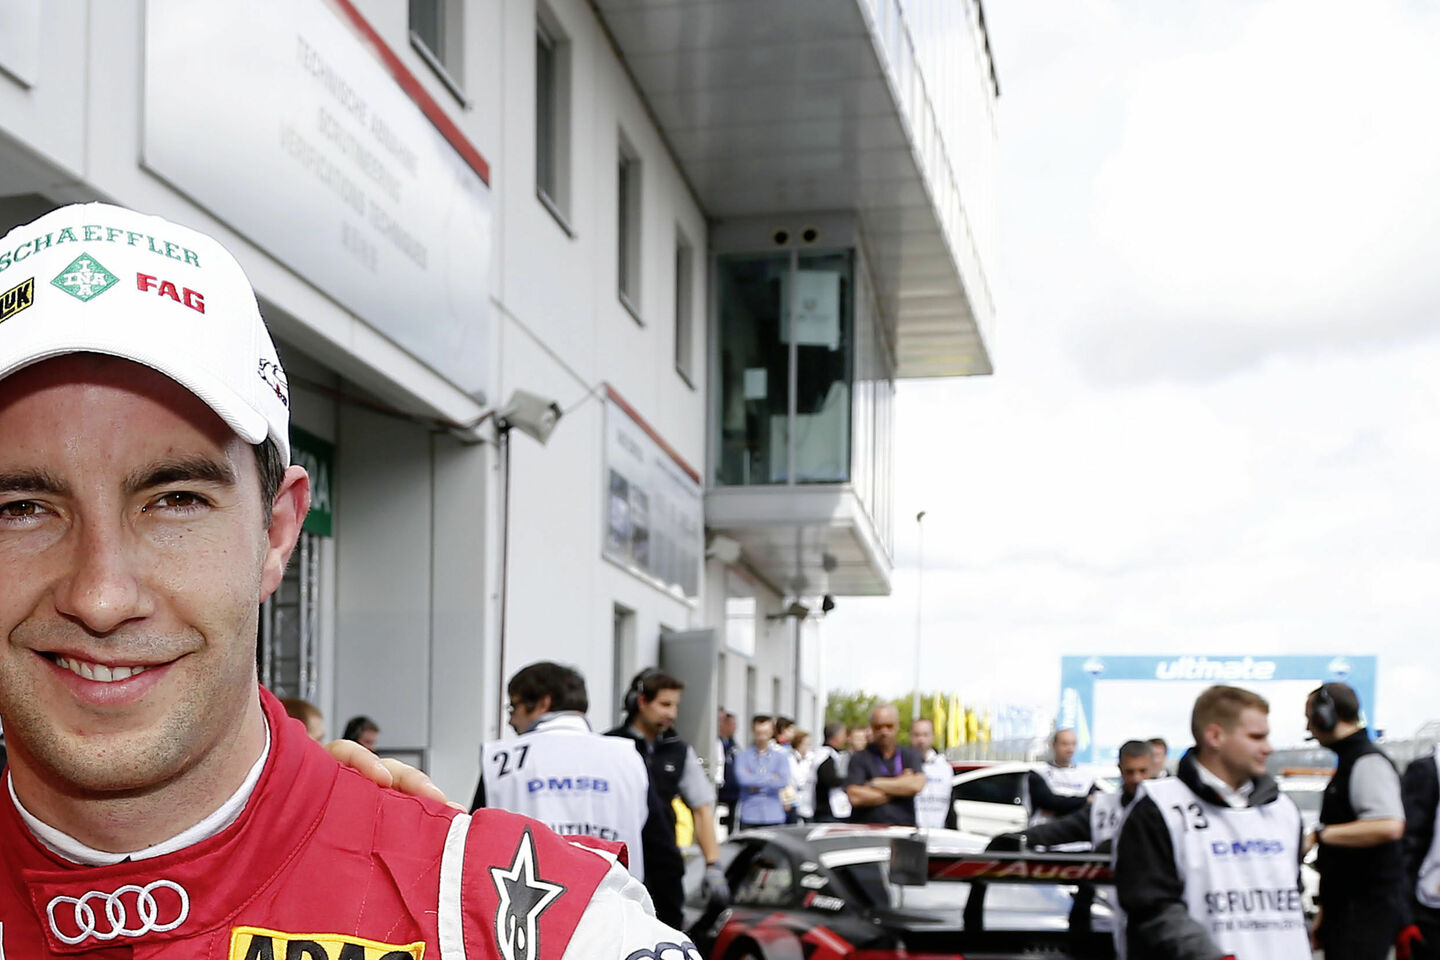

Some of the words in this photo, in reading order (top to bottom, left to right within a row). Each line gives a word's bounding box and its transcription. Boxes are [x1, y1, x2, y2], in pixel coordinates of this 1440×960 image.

[137, 271, 206, 315] FAG
[492, 744, 531, 778] 27
[527, 776, 609, 793] DMSB
[1172, 802, 1209, 832] 13
